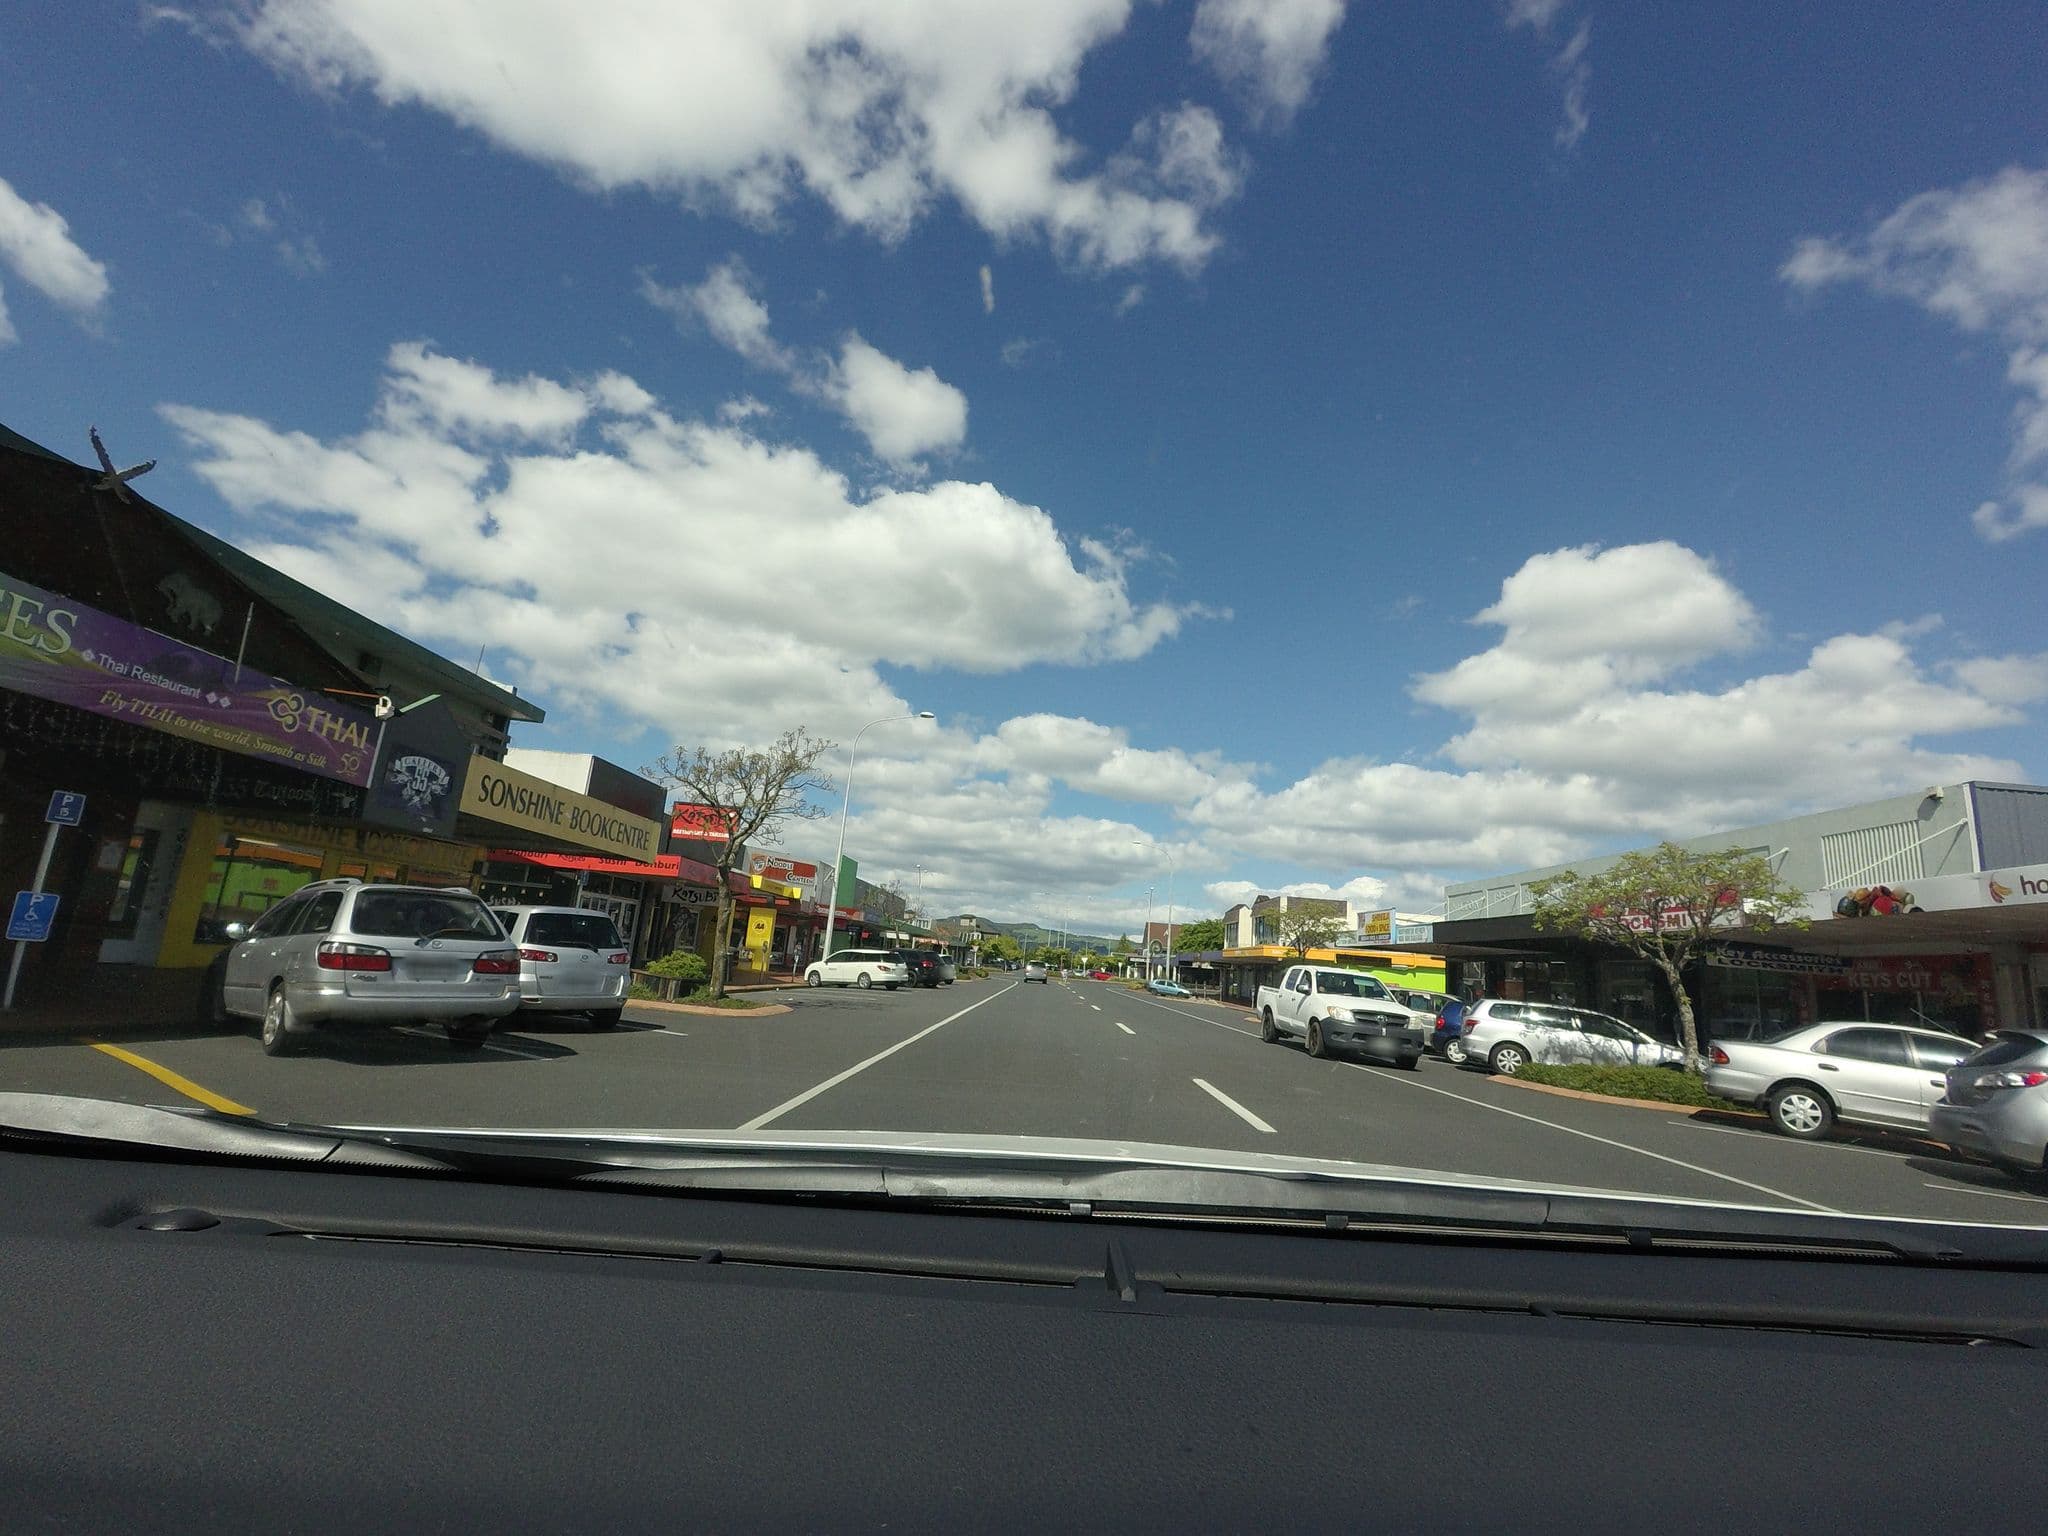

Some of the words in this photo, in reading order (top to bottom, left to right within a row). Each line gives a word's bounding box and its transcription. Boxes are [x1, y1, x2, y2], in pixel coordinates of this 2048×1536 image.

[0, 588, 78, 654] ES
[98, 653, 128, 675] Thai
[131, 665, 201, 699] Restaurant
[99, 690, 127, 713] Fly
[129, 697, 173, 723] THAI
[174, 716, 189, 729] to
[190, 718, 210, 735] the
[213, 726, 250, 748] world,
[253, 736, 294, 759] Smooth
[295, 750, 306, 762] as
[307, 751, 327, 768] Silk
[306, 707, 369, 750] THAI
[62, 795, 73, 806] P
[478, 775, 564, 825] SONSHINE
[569, 808, 650, 851] BOOKCENTRE
[30, 895, 44, 906] P
[1849, 971, 1893, 989] KEYS
[1897, 971, 1932, 988] CUT
